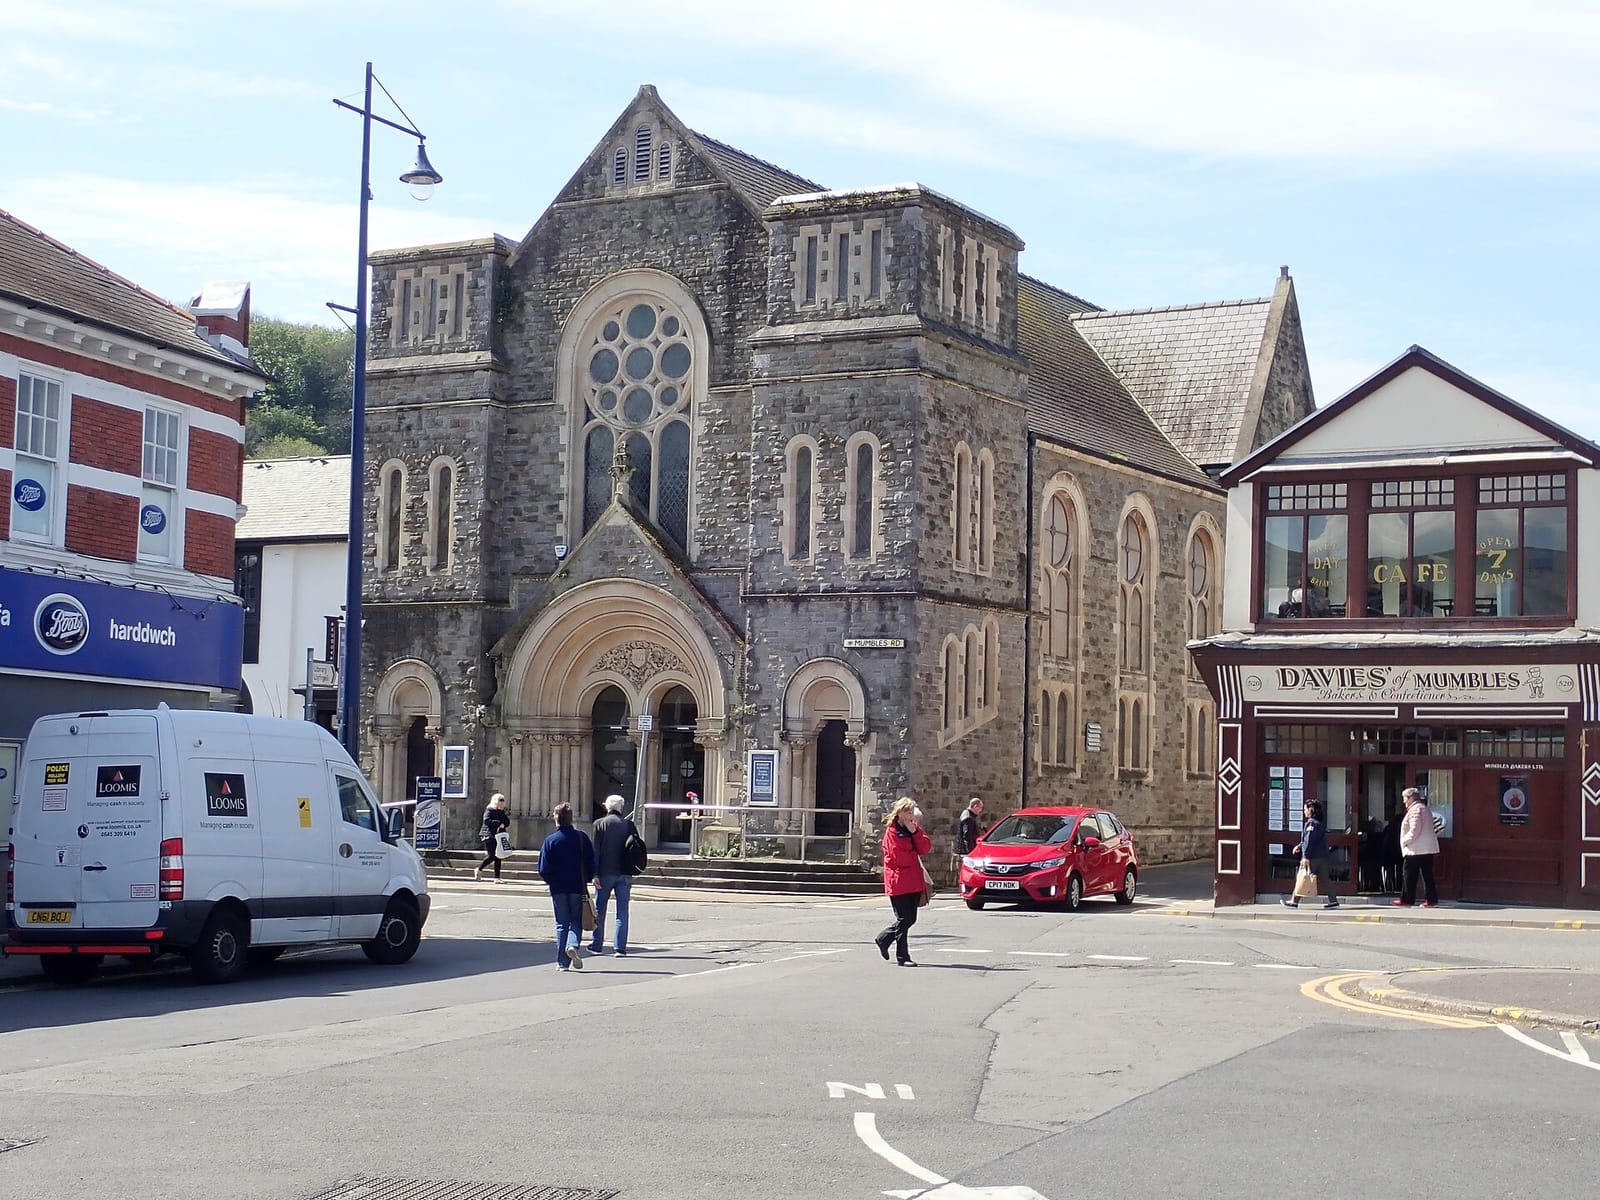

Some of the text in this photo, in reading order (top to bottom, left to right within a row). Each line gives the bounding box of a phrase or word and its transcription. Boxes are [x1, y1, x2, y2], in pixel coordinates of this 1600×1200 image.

[17, 485, 41, 503] Boots
[142, 510, 162, 527] Boots
[1479, 536, 1514, 550] OPEN
[1313, 556, 1341, 570] DAY
[1487, 549, 1507, 569] 7
[1479, 569, 1514, 585] DAYS
[46, 608, 83, 640] Boots
[109, 618, 177, 647] harddwch
[854, 639, 901, 647] MUMBLES RD
[1277, 666, 1521, 691] DAVIES' of MUMBLES
[1317, 688, 1451, 701] Bakers & Confectioners
[46, 765, 69, 773] POLICE
[99, 782, 137, 793] LOOMIS
[209, 795, 245, 810] LOOMIS
[200, 821, 223, 830] Managing
[1003, 881, 1016, 889] NDK
[31, 912, 50, 922] CN61
